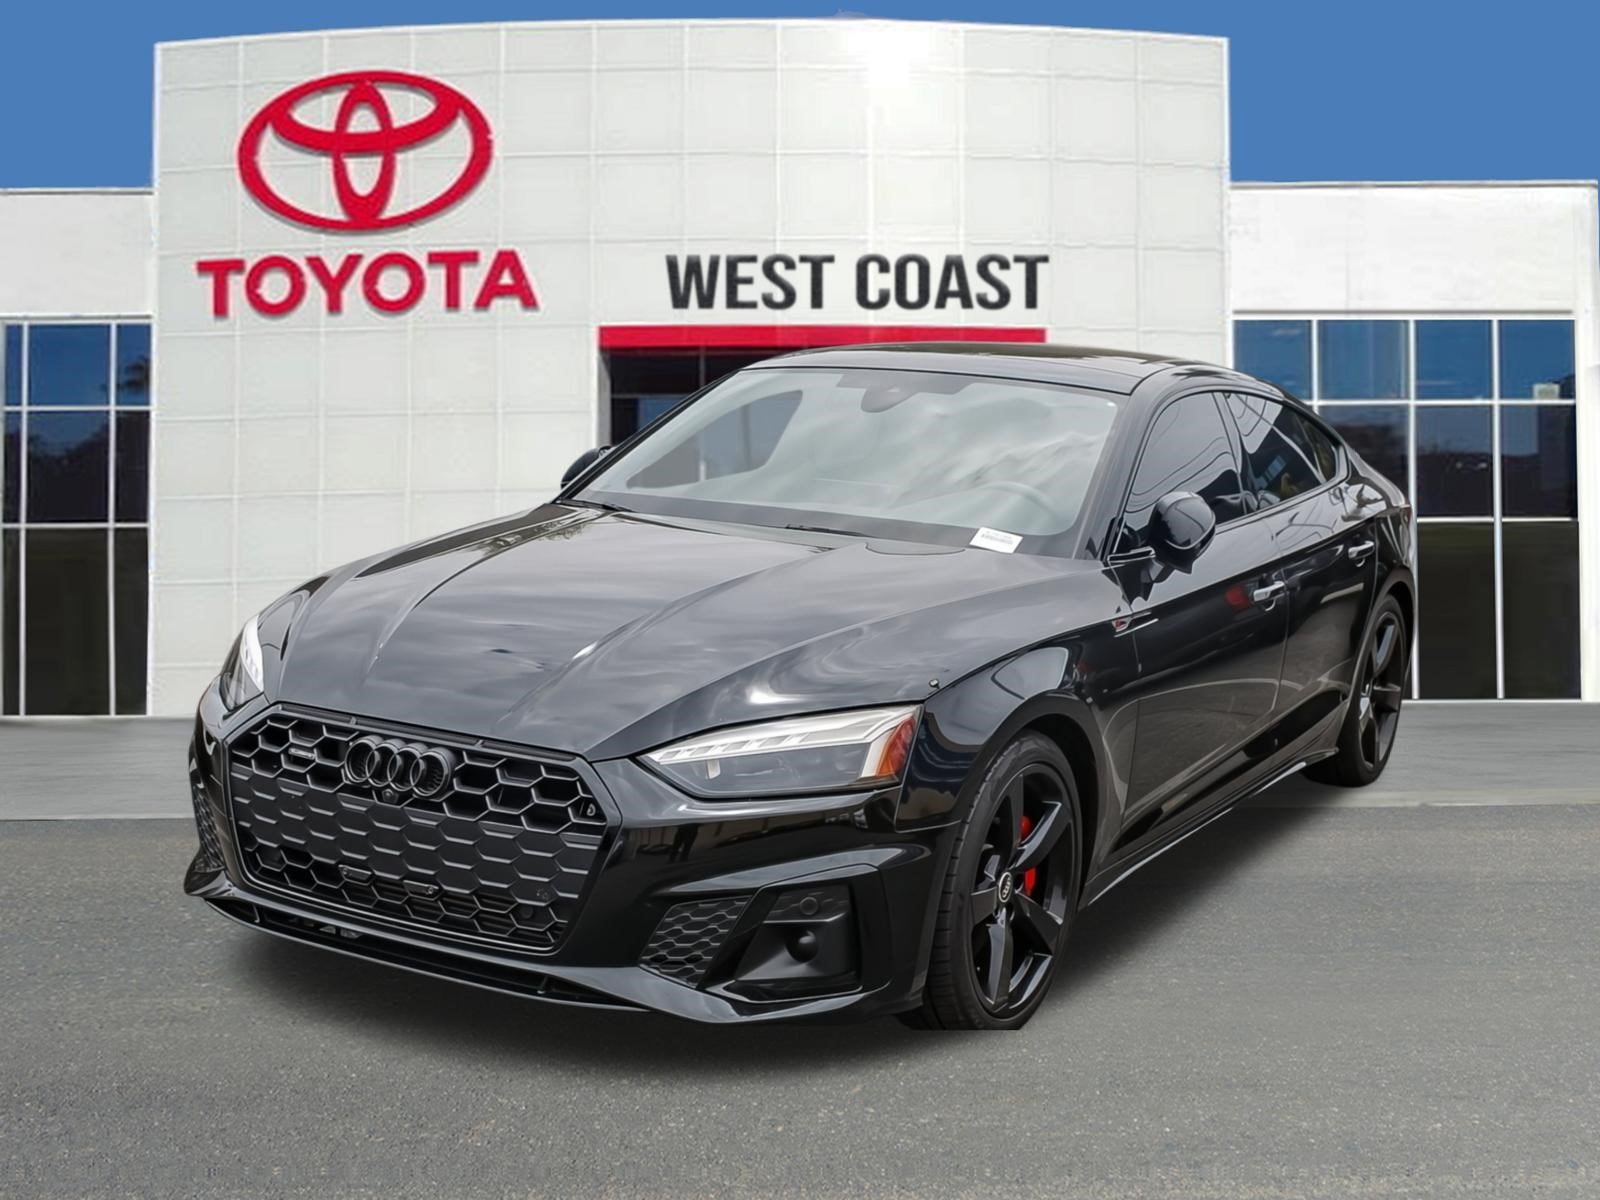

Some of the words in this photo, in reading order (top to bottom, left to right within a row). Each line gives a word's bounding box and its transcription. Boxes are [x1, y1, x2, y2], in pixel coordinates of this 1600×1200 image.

[196, 249, 538, 317] TOYOTA
[665, 254, 835, 311] WEST
[855, 254, 1050, 311] COAST
